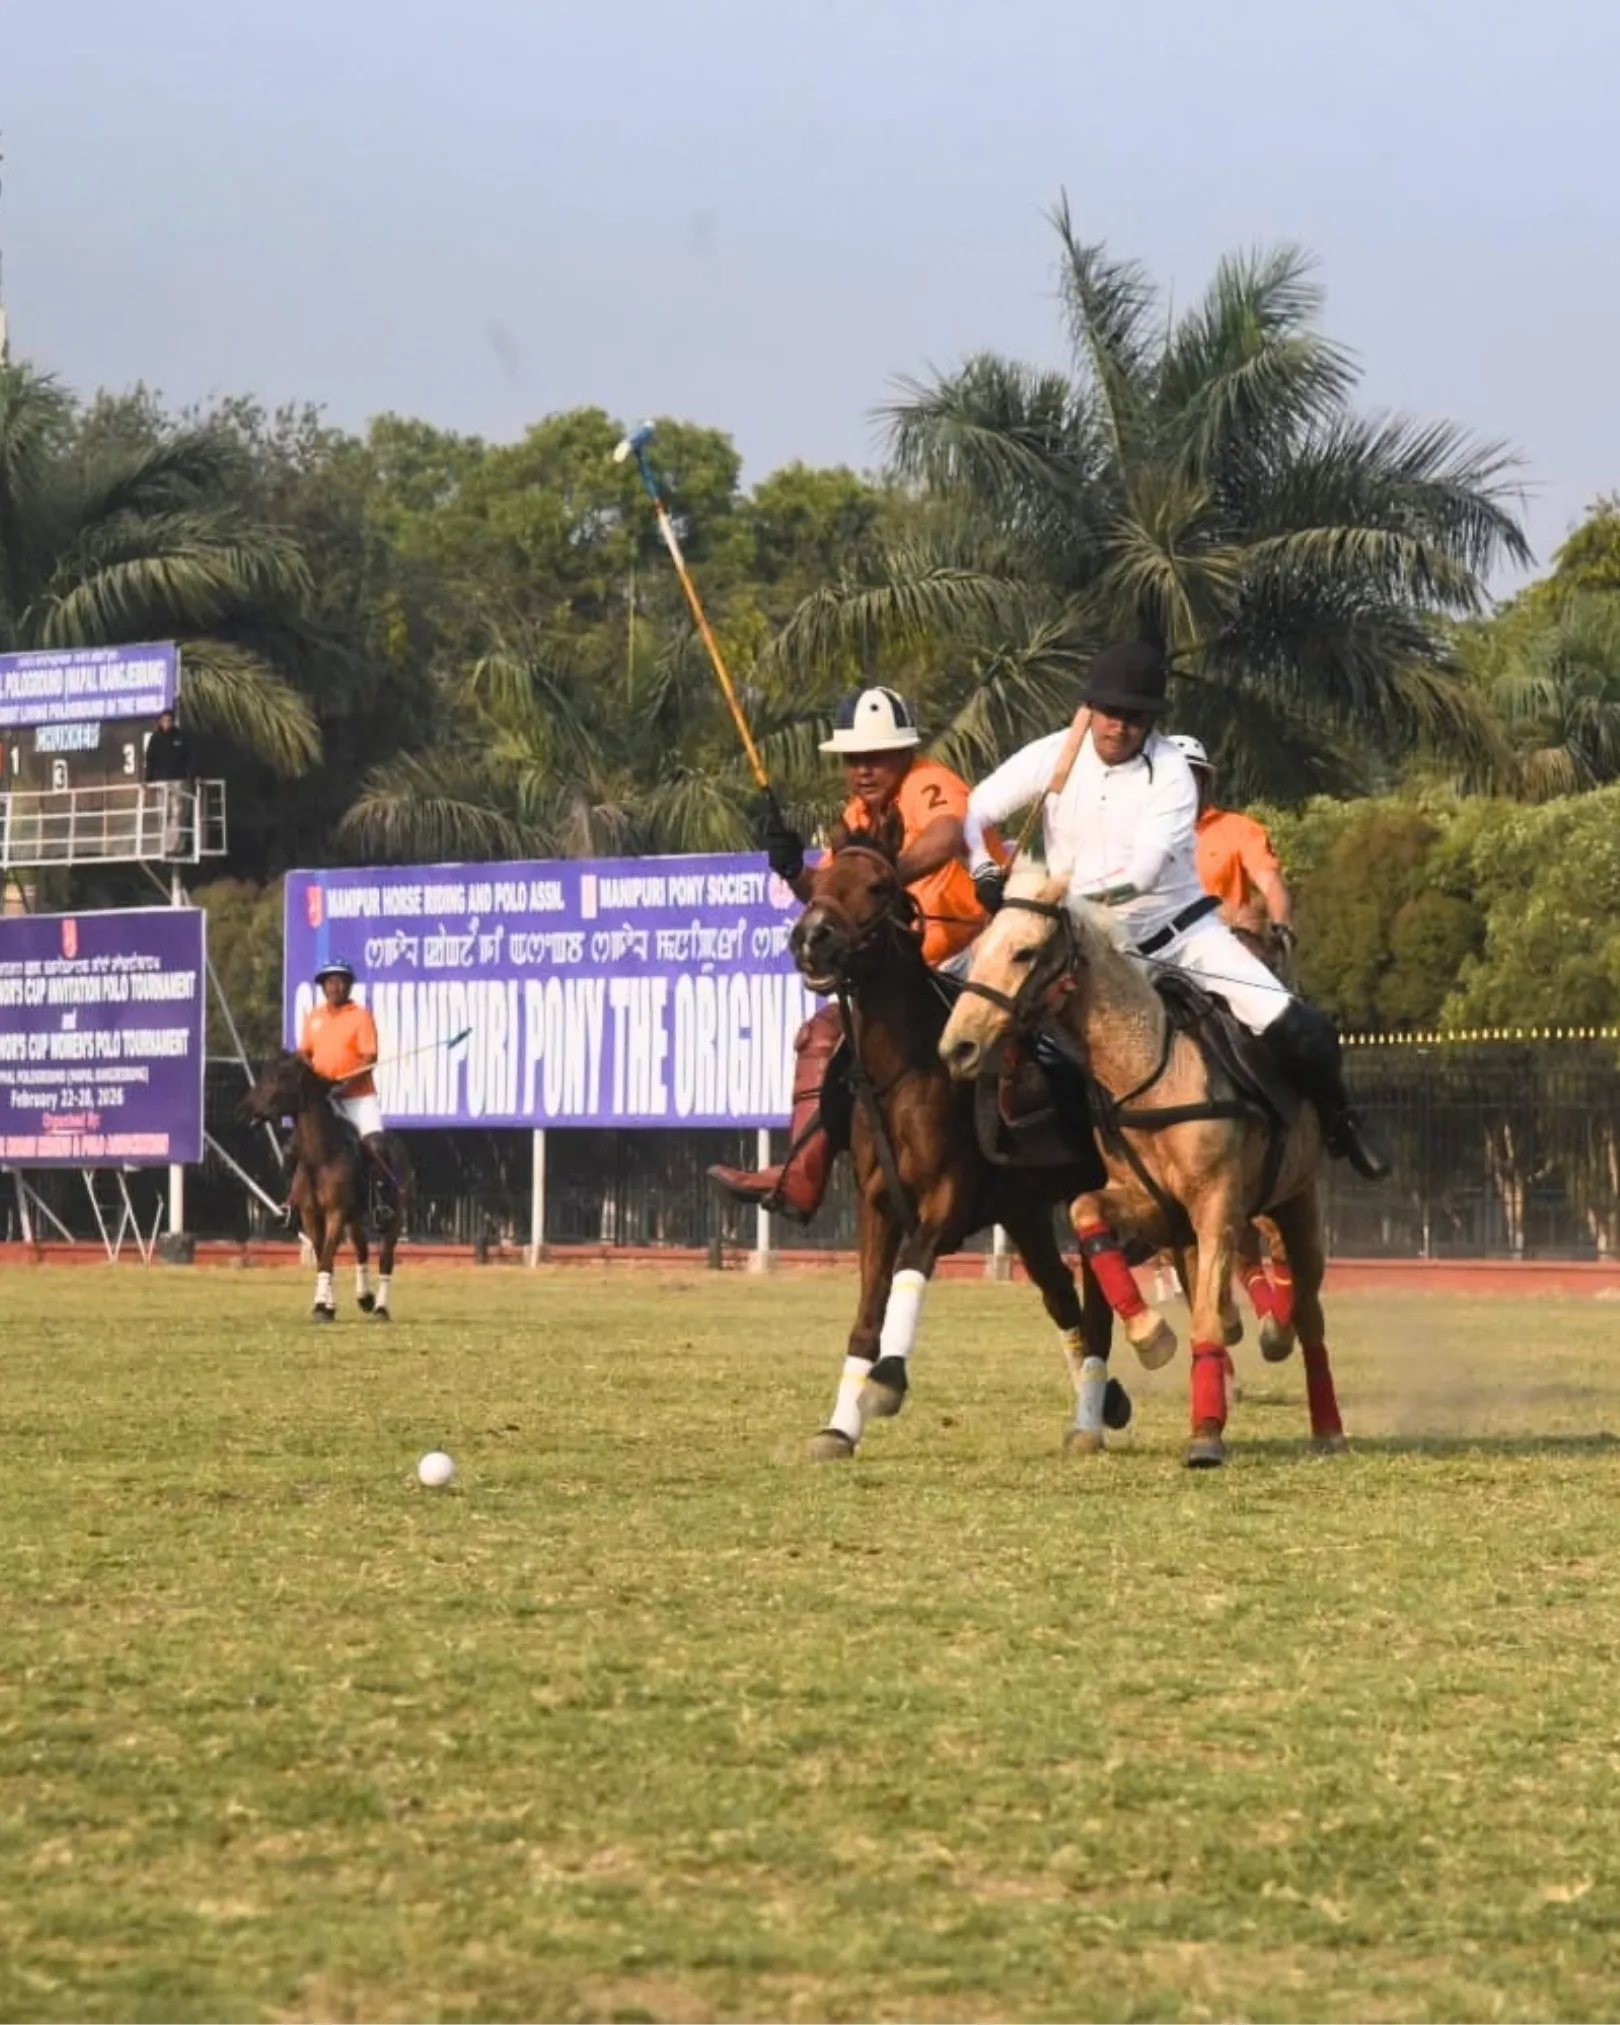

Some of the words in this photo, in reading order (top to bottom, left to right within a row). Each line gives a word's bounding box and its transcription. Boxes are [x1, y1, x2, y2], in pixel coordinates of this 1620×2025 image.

[10, 745, 20, 775] 1
[122, 743, 135, 774] 3
[920, 783, 948, 810] 2
[327, 888, 380, 918] MANIPUR
[382, 886, 423, 915] HORSE
[424, 885, 465, 914] RIDING
[468, 883, 492, 913] AND
[494, 881, 527, 911] POLO
[600, 875, 666, 909] MANIPURI
[669, 875, 705, 907] PONY
[707, 873, 767, 905] SOCIETY
[25, 976, 46, 1005] CUP
[47, 975, 100, 1004] INVITATION
[103, 973, 129, 1002] POLO
[131, 971, 196, 1000] TOURNAMENT
[28, 1032, 49, 1060] CUP
[95, 1031, 121, 1058] POLO
[122, 1027, 189, 1056] TOURNAMENT
[374, 978, 518, 1117] MANIPURI
[524, 976, 604, 1117] PONY
[609, 974, 668, 1116] THE
[674, 971, 817, 1116] ORIGINA
[10, 1088, 57, 1111] February
[98, 1087, 124, 1106] 2026
